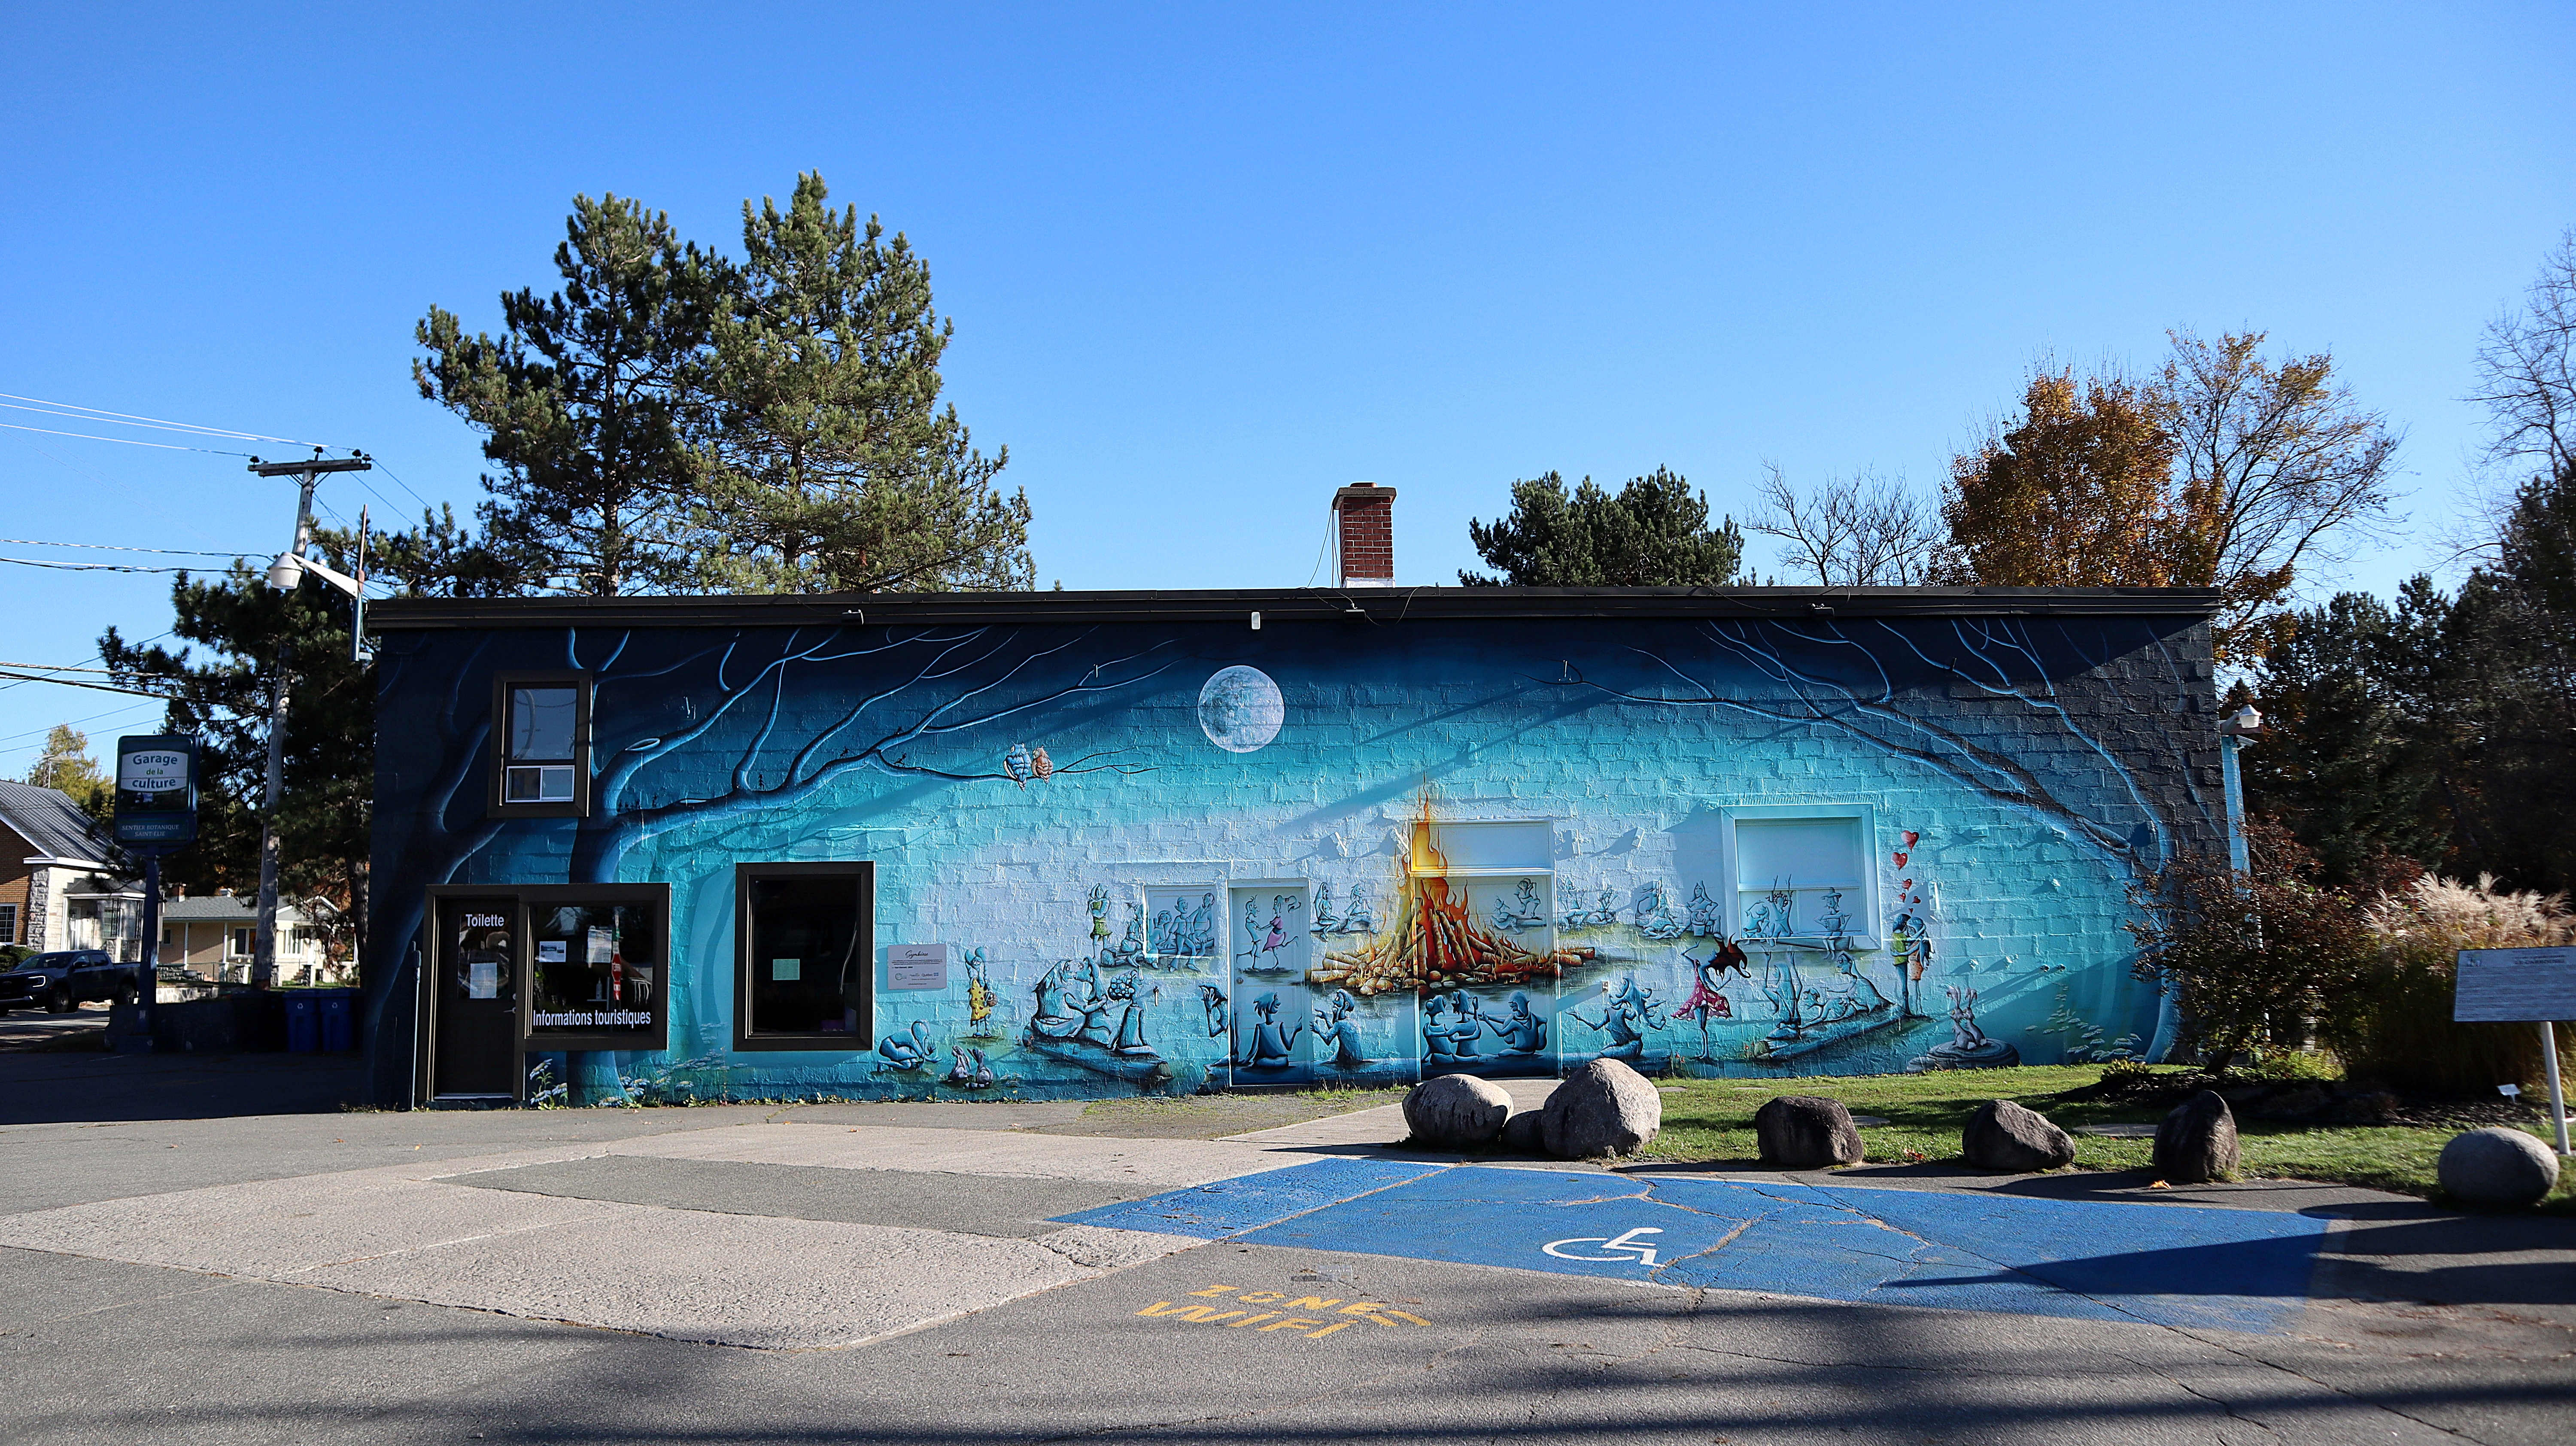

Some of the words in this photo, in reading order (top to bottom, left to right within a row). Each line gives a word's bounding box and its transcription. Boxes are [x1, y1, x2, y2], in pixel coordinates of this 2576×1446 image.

[133, 754, 178, 766] Garage
[132, 778, 176, 789] culture
[465, 913, 504, 927] Toilette
[905, 950, 928, 959] Symbiose
[533, 1009, 592, 1026] Informations
[595, 1009, 651, 1029] touristiques
[1184, 1285, 1386, 1315] ZONE
